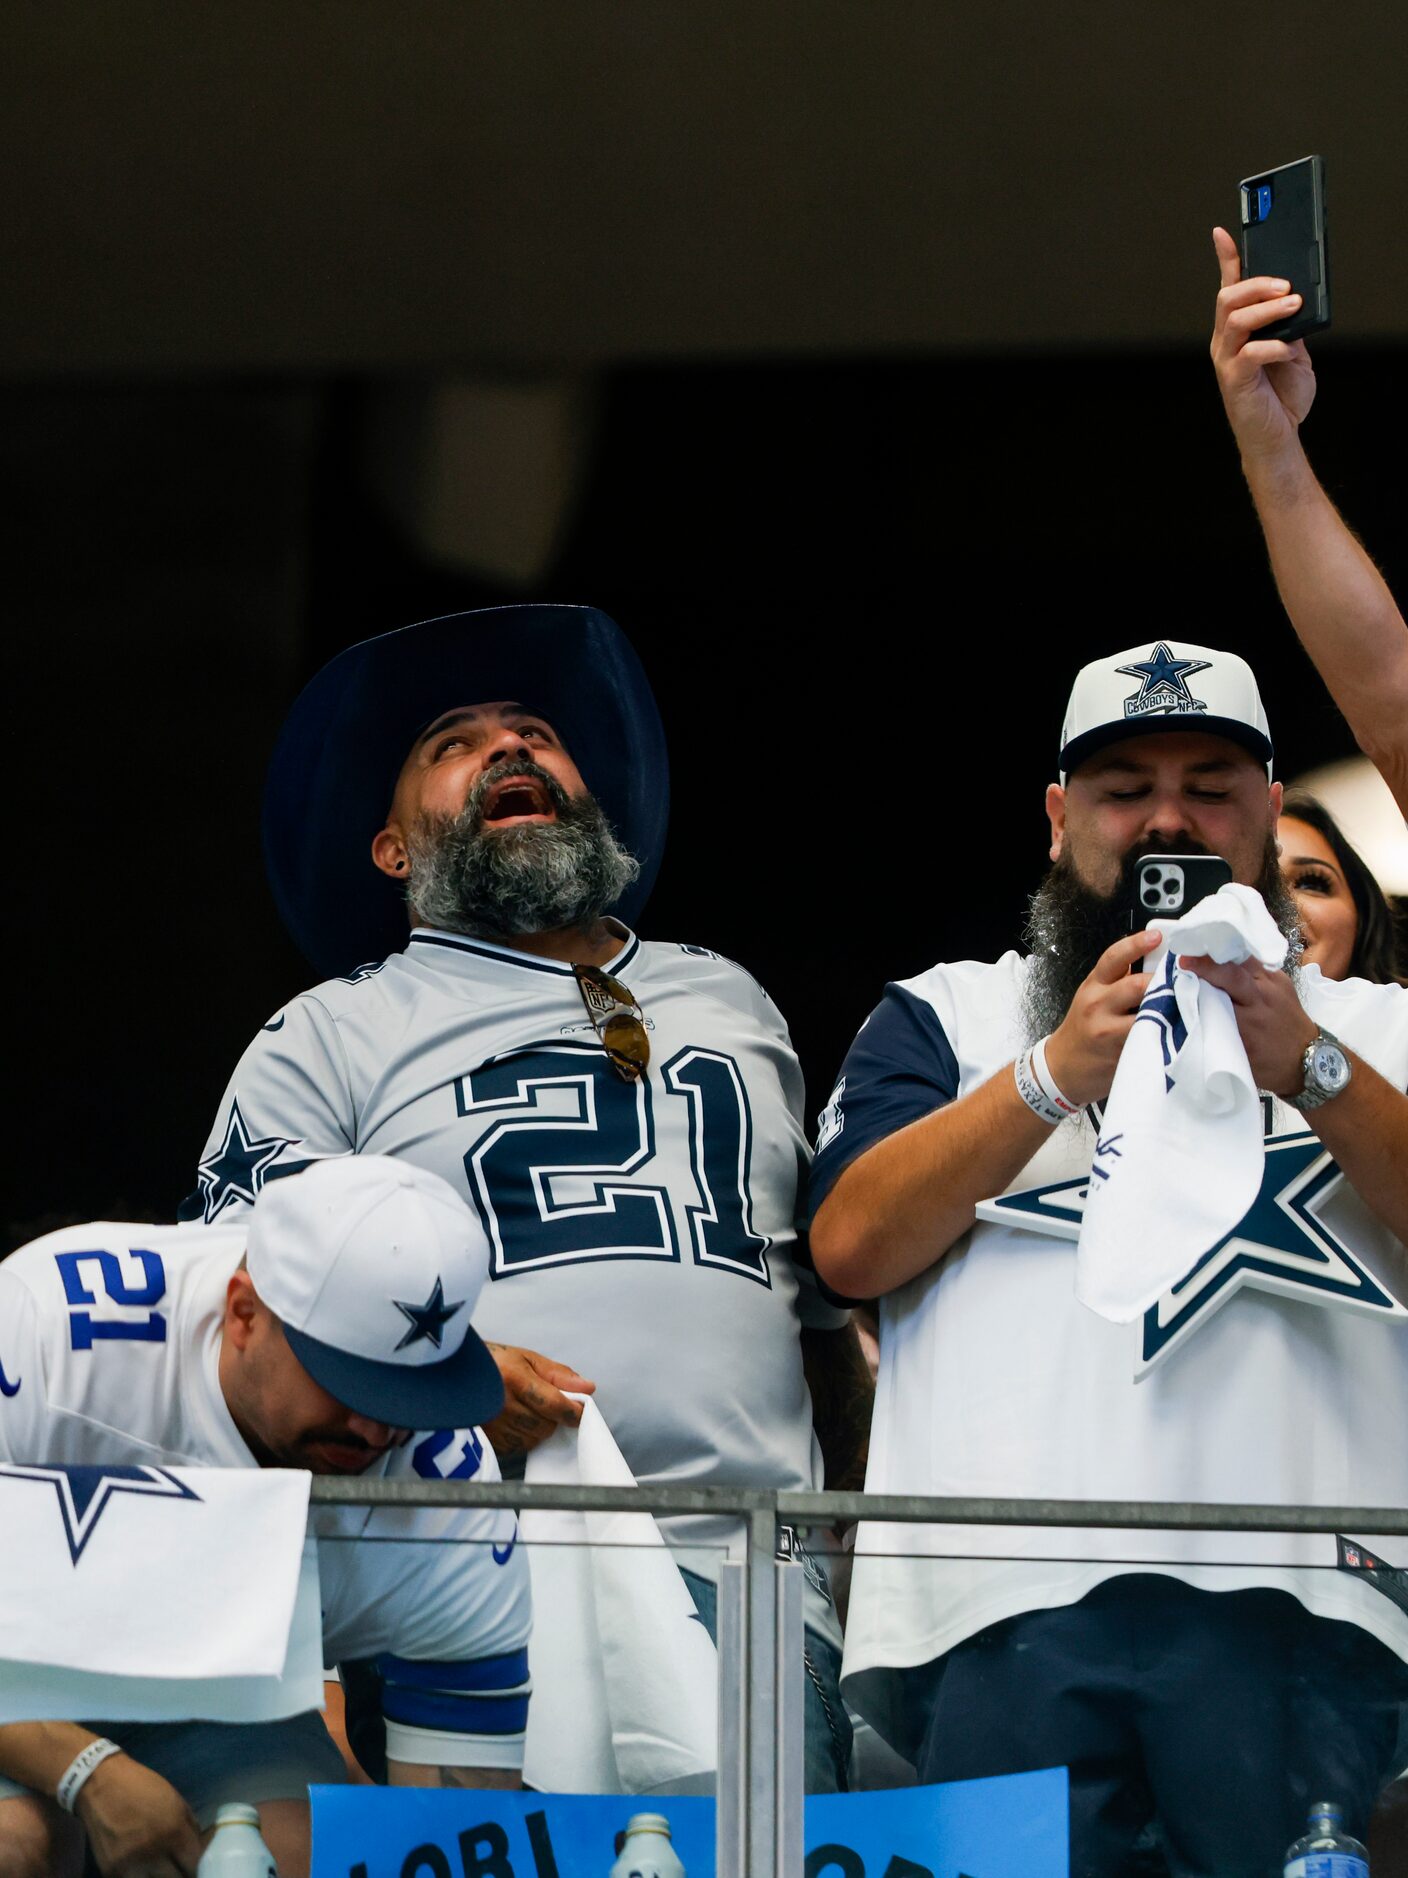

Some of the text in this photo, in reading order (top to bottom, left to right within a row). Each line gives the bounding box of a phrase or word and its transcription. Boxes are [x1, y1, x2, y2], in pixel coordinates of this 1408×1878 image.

[1127, 694, 1175, 715] COWBOYS
[454, 1039, 772, 1291] 21
[54, 1248, 167, 1351] 21
